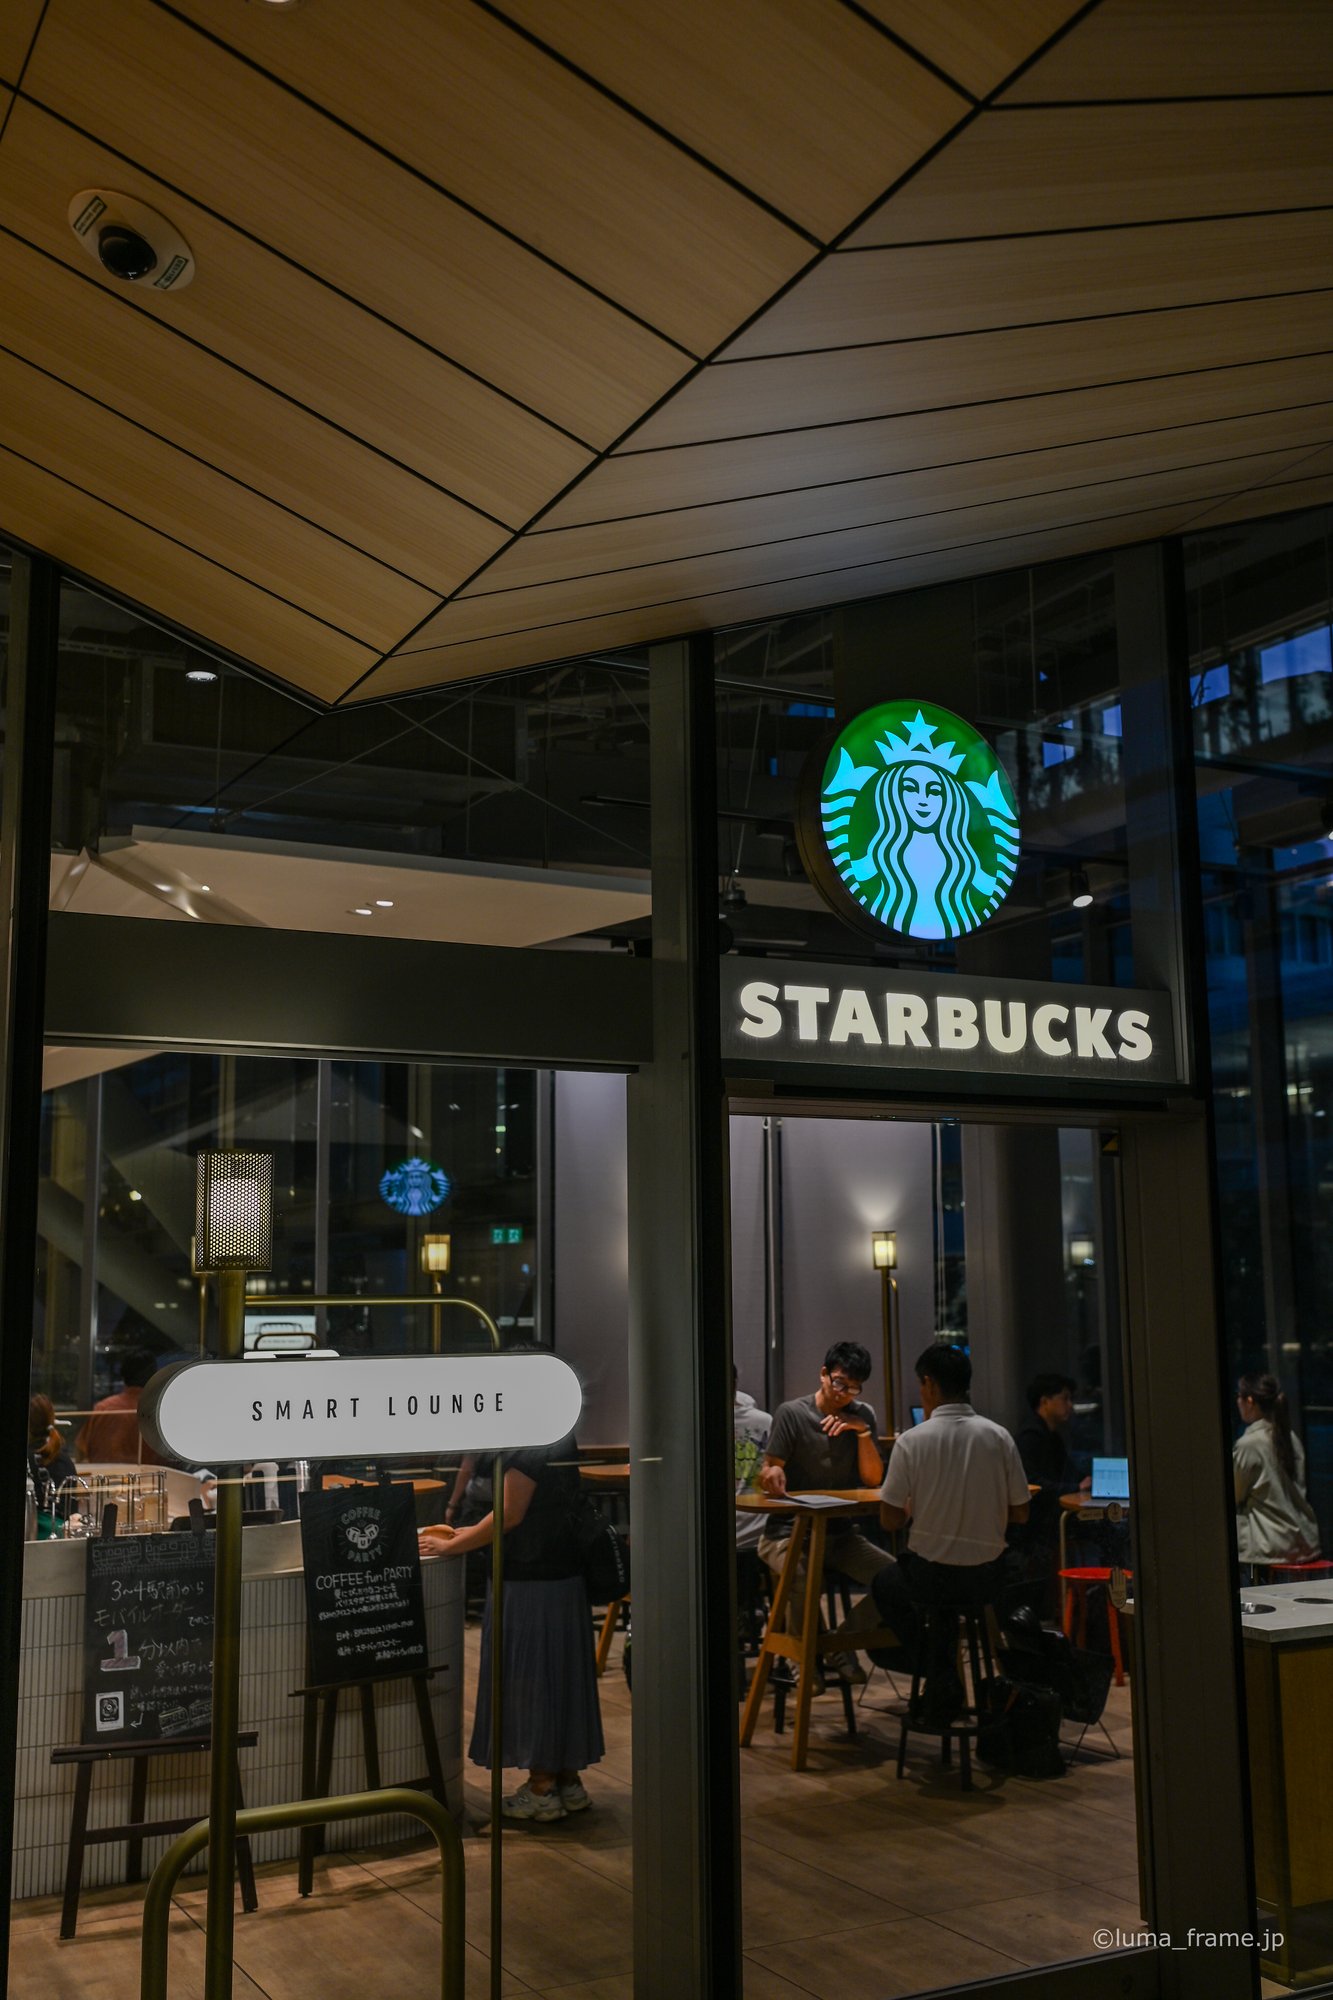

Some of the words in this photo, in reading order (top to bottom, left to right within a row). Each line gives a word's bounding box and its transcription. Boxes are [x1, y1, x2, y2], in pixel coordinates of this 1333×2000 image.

[740, 981, 1153, 1061] STARBUCKS
[252, 1398, 360, 1421] SMART
[388, 1392, 503, 1416] LOUNGE
[341, 1507, 382, 1525] COFFEE
[347, 1544, 383, 1563] PARTY
[315, 1572, 364, 1591] COFFEE
[364, 1570, 383, 1584] fun
[383, 1565, 413, 1582] PARTY
